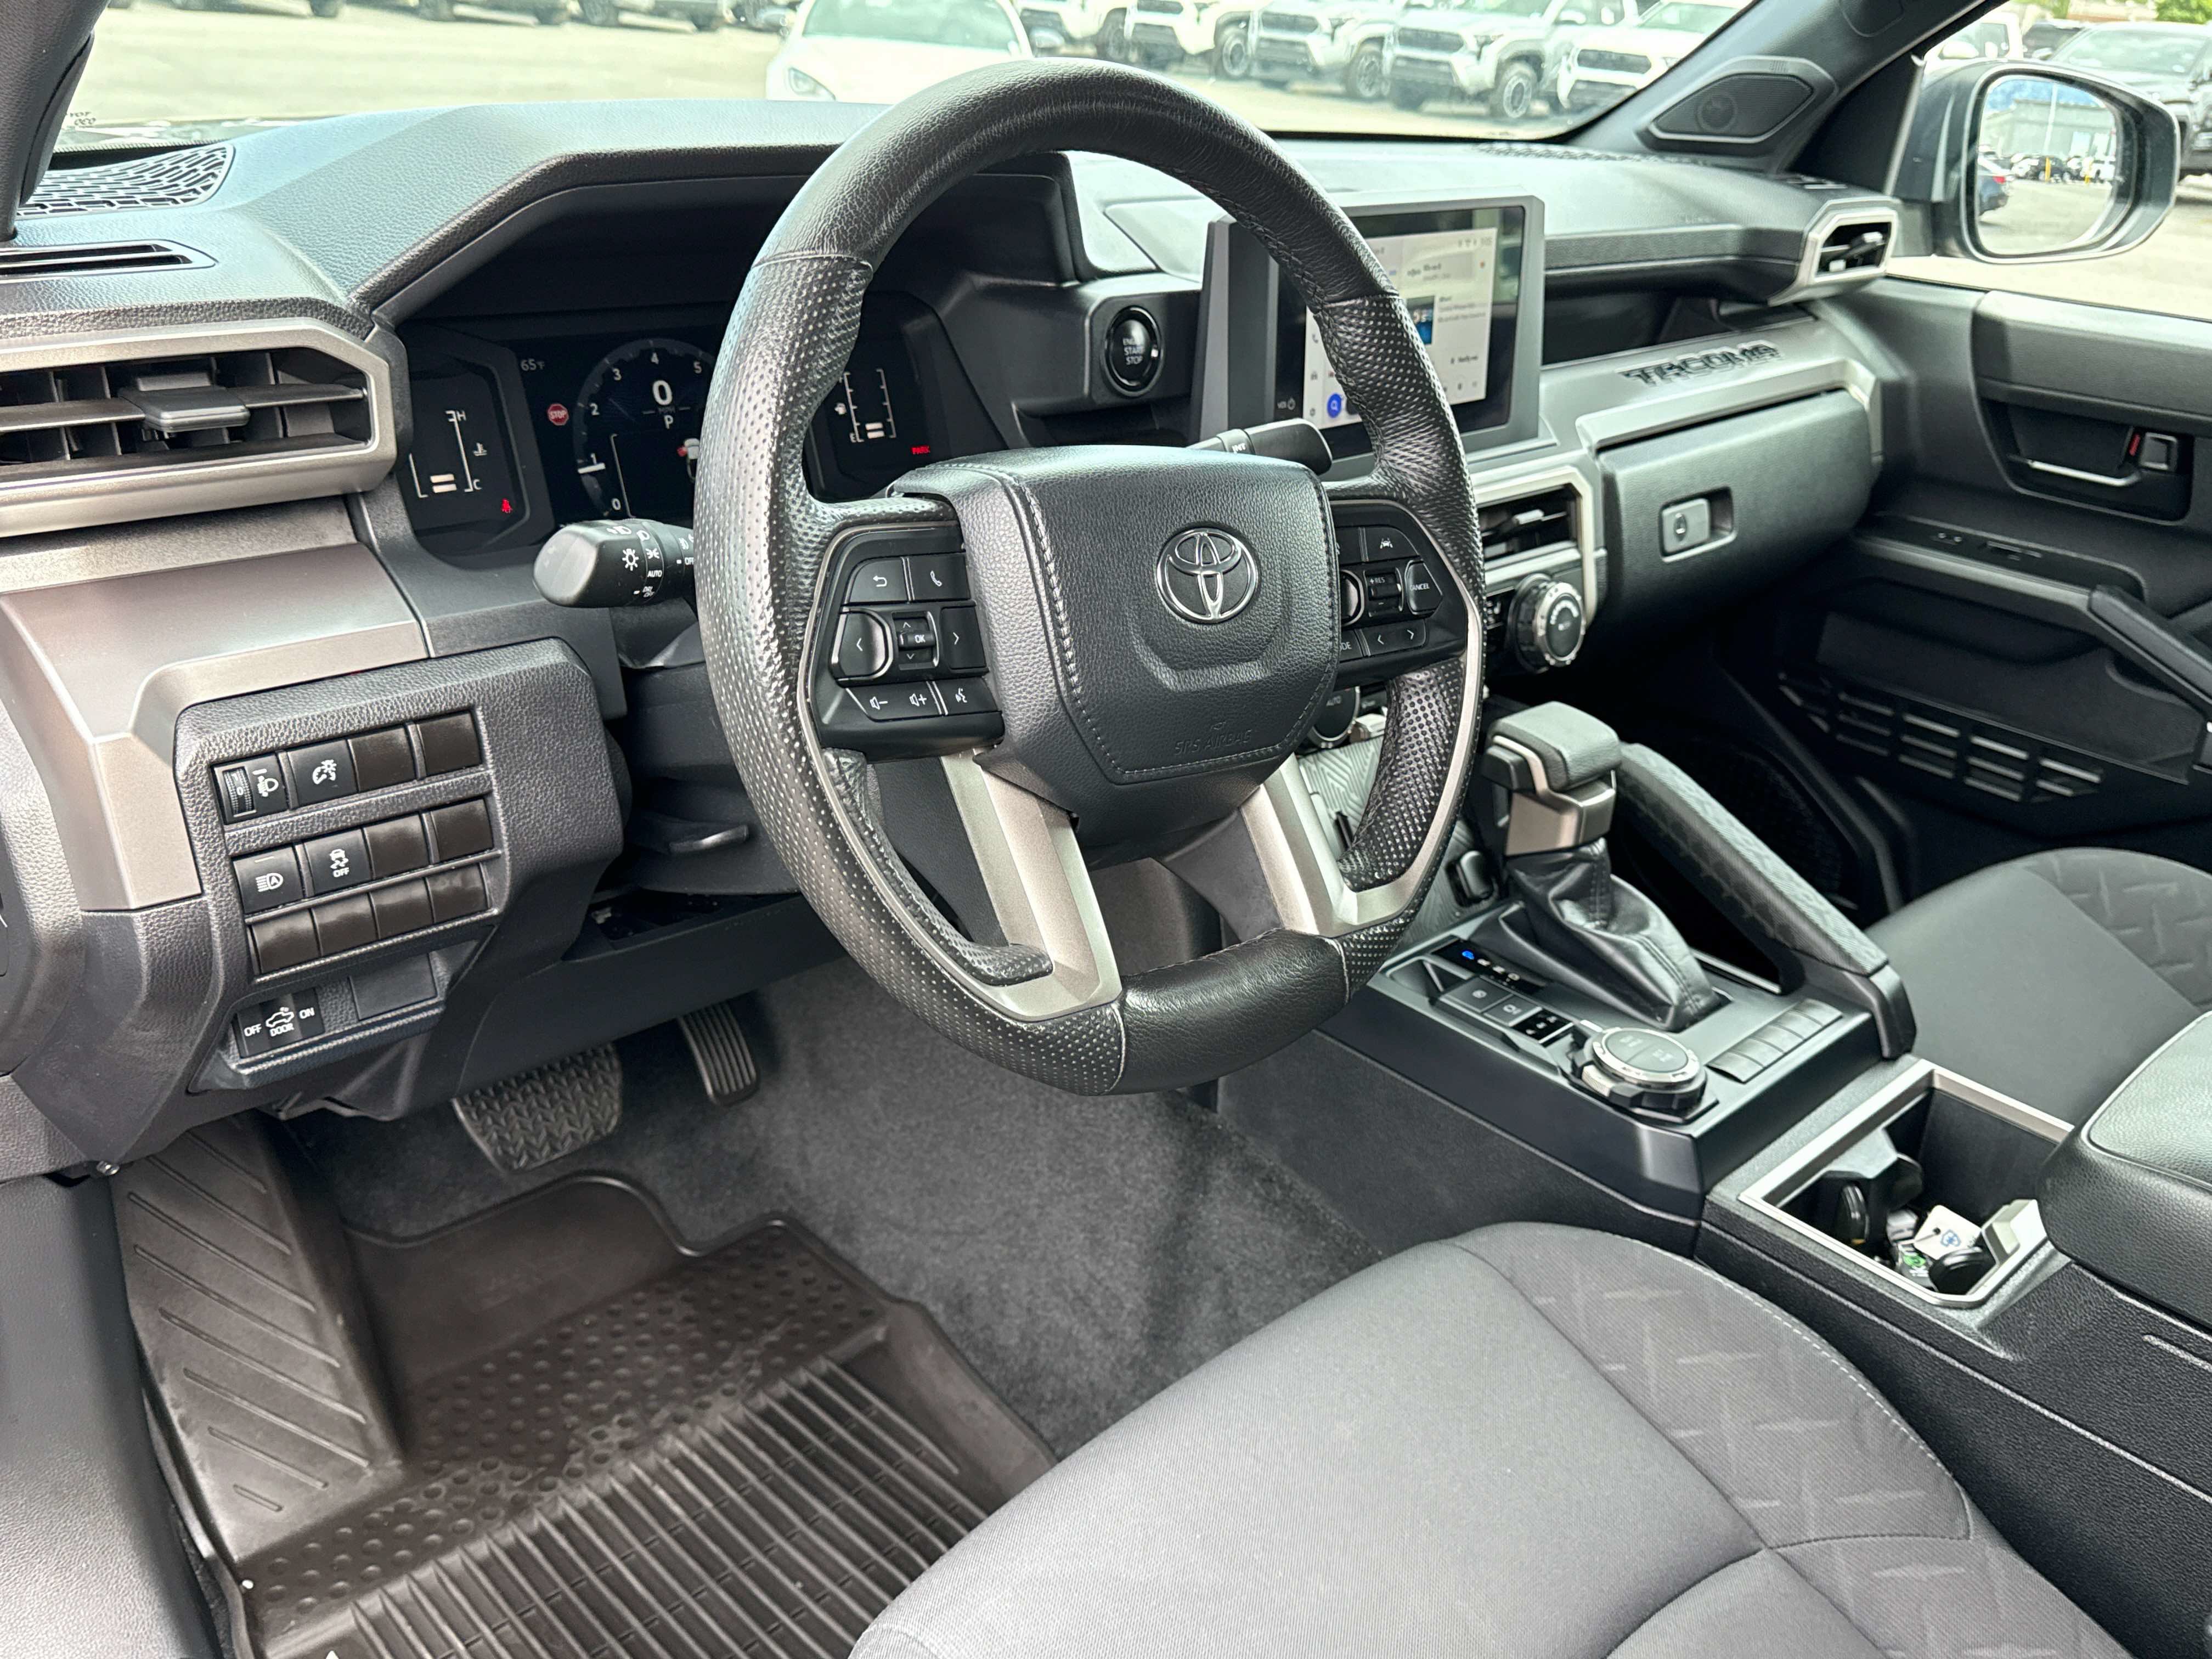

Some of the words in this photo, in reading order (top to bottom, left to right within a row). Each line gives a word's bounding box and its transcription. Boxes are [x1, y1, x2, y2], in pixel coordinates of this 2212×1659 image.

[1124, 346, 1145, 356] START
[651, 352, 659, 364] 4
[1126, 356, 1143, 365] STOP
[1616, 341, 1784, 387] TACOMA
[693, 361, 702, 374] 5
[612, 368, 622, 381] 3
[652, 380, 673, 405] 0
[549, 410, 567, 419] STOP
[590, 403, 600, 416] 2
[664, 414, 674, 430] P
[912, 445, 930, 455] PARK
[473, 479, 482, 490] C
[612, 498, 621, 511] 0
[647, 569, 663, 578] AUTO
[1409, 583, 1430, 591] CANCEL
[915, 634, 927, 644] OK
[1175, 739, 1200, 755] SRS
[1204, 729, 1252, 749] AIRBAG
[333, 867, 350, 878] OFF
[299, 1007, 316, 1019] ON
[244, 1023, 263, 1037] OFF
[269, 1022, 295, 1037] DOOR
